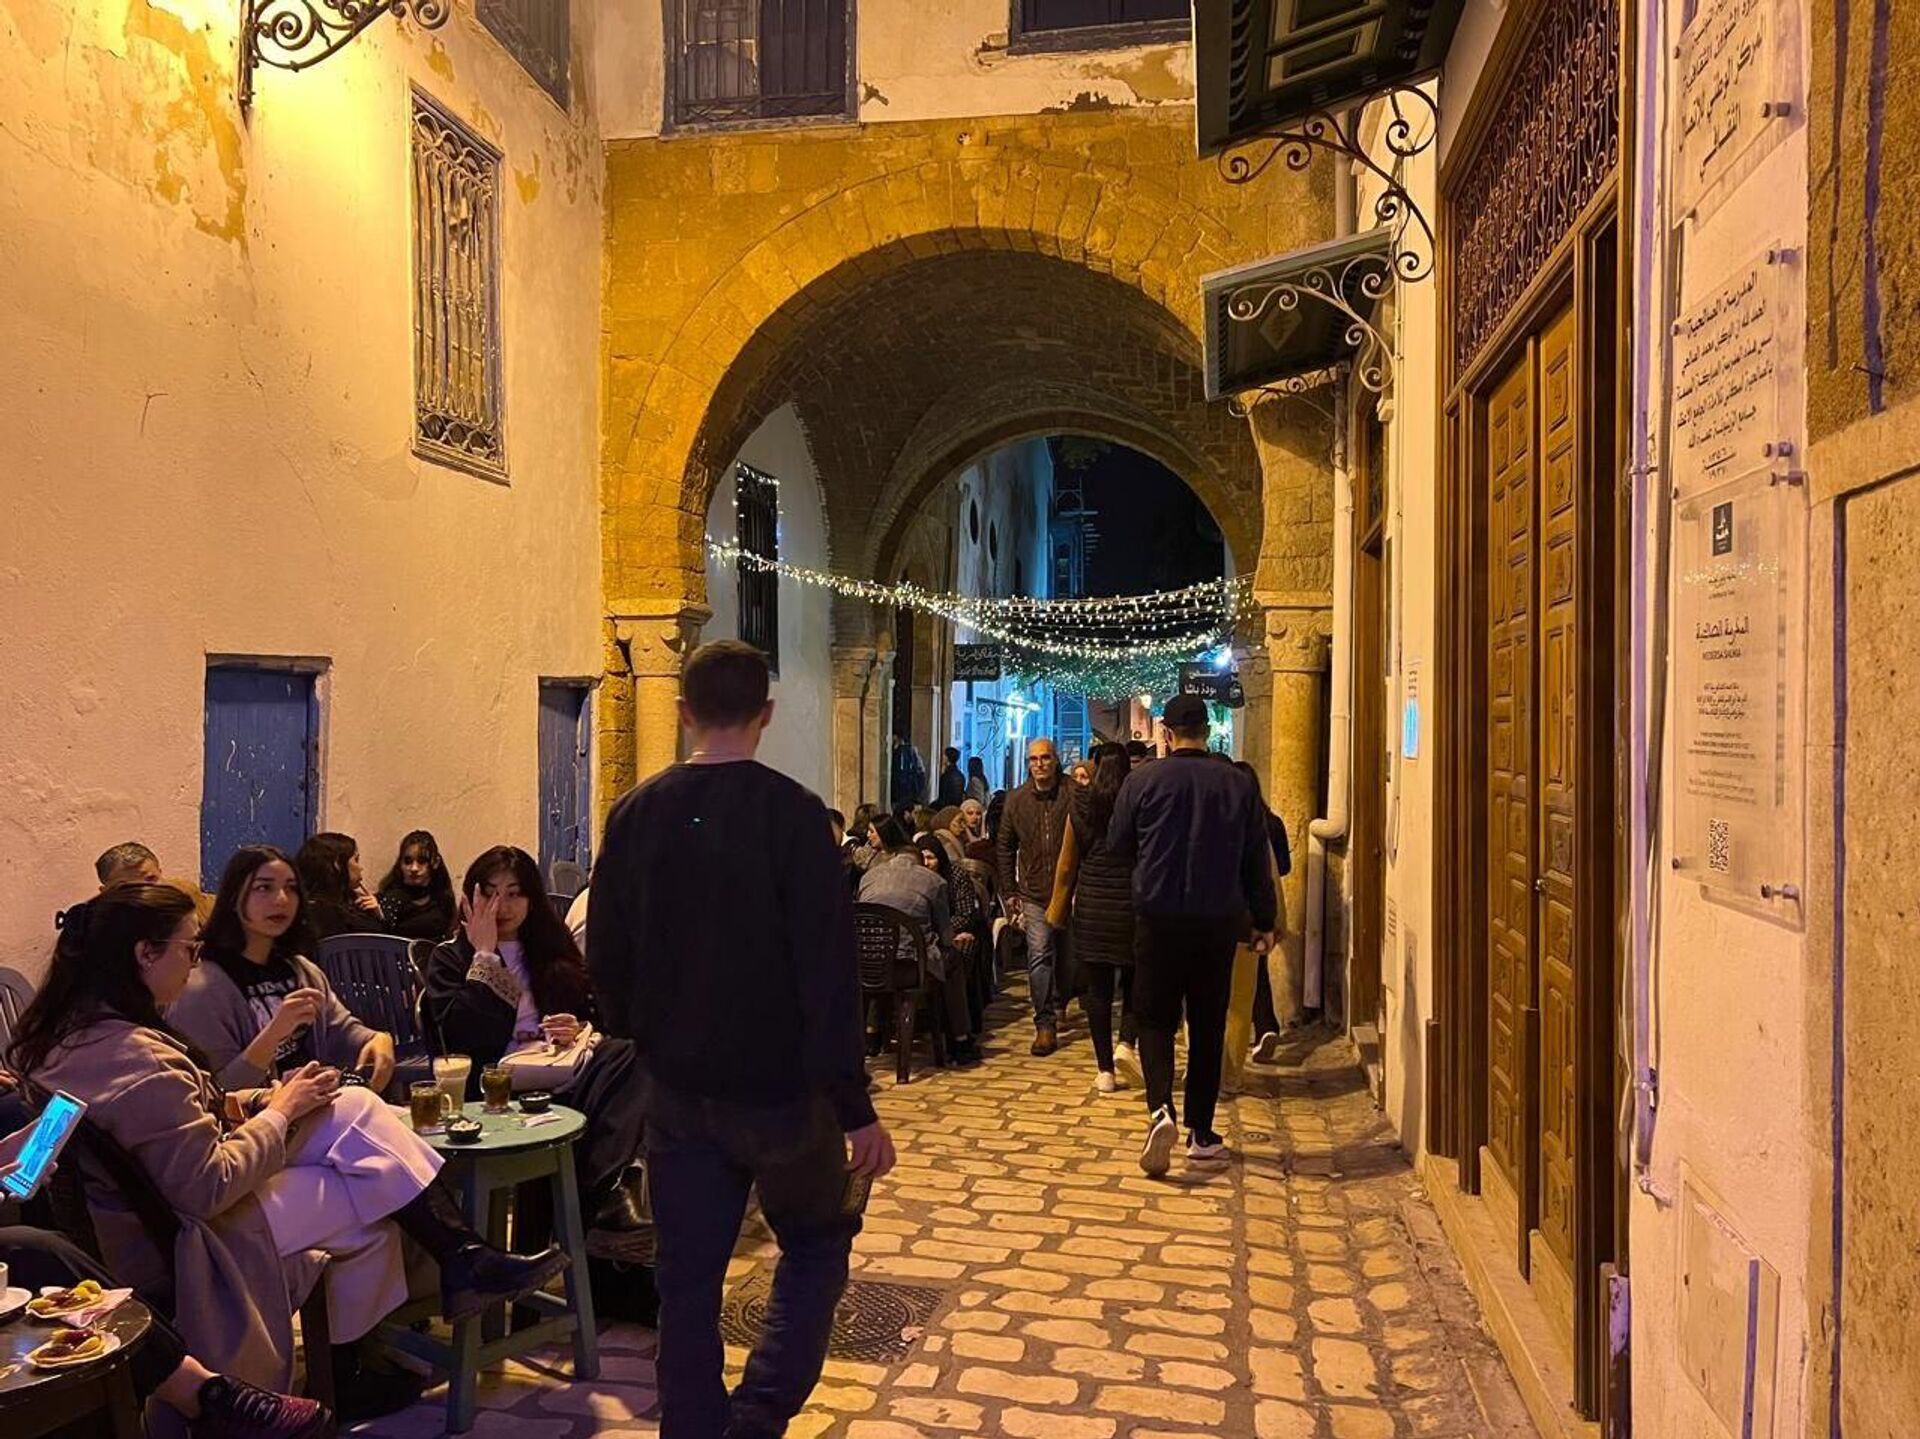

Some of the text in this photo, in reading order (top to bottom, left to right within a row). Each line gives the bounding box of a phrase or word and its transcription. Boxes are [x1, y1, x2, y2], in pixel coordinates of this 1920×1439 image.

[1682, 42, 1713, 98] الثقافية
[1732, 13, 1765, 84] المركز
[1706, 57, 1734, 123] الوطني
[1723, 268, 1758, 313] المدرسة
[1724, 615, 1749, 646] المدرسة
